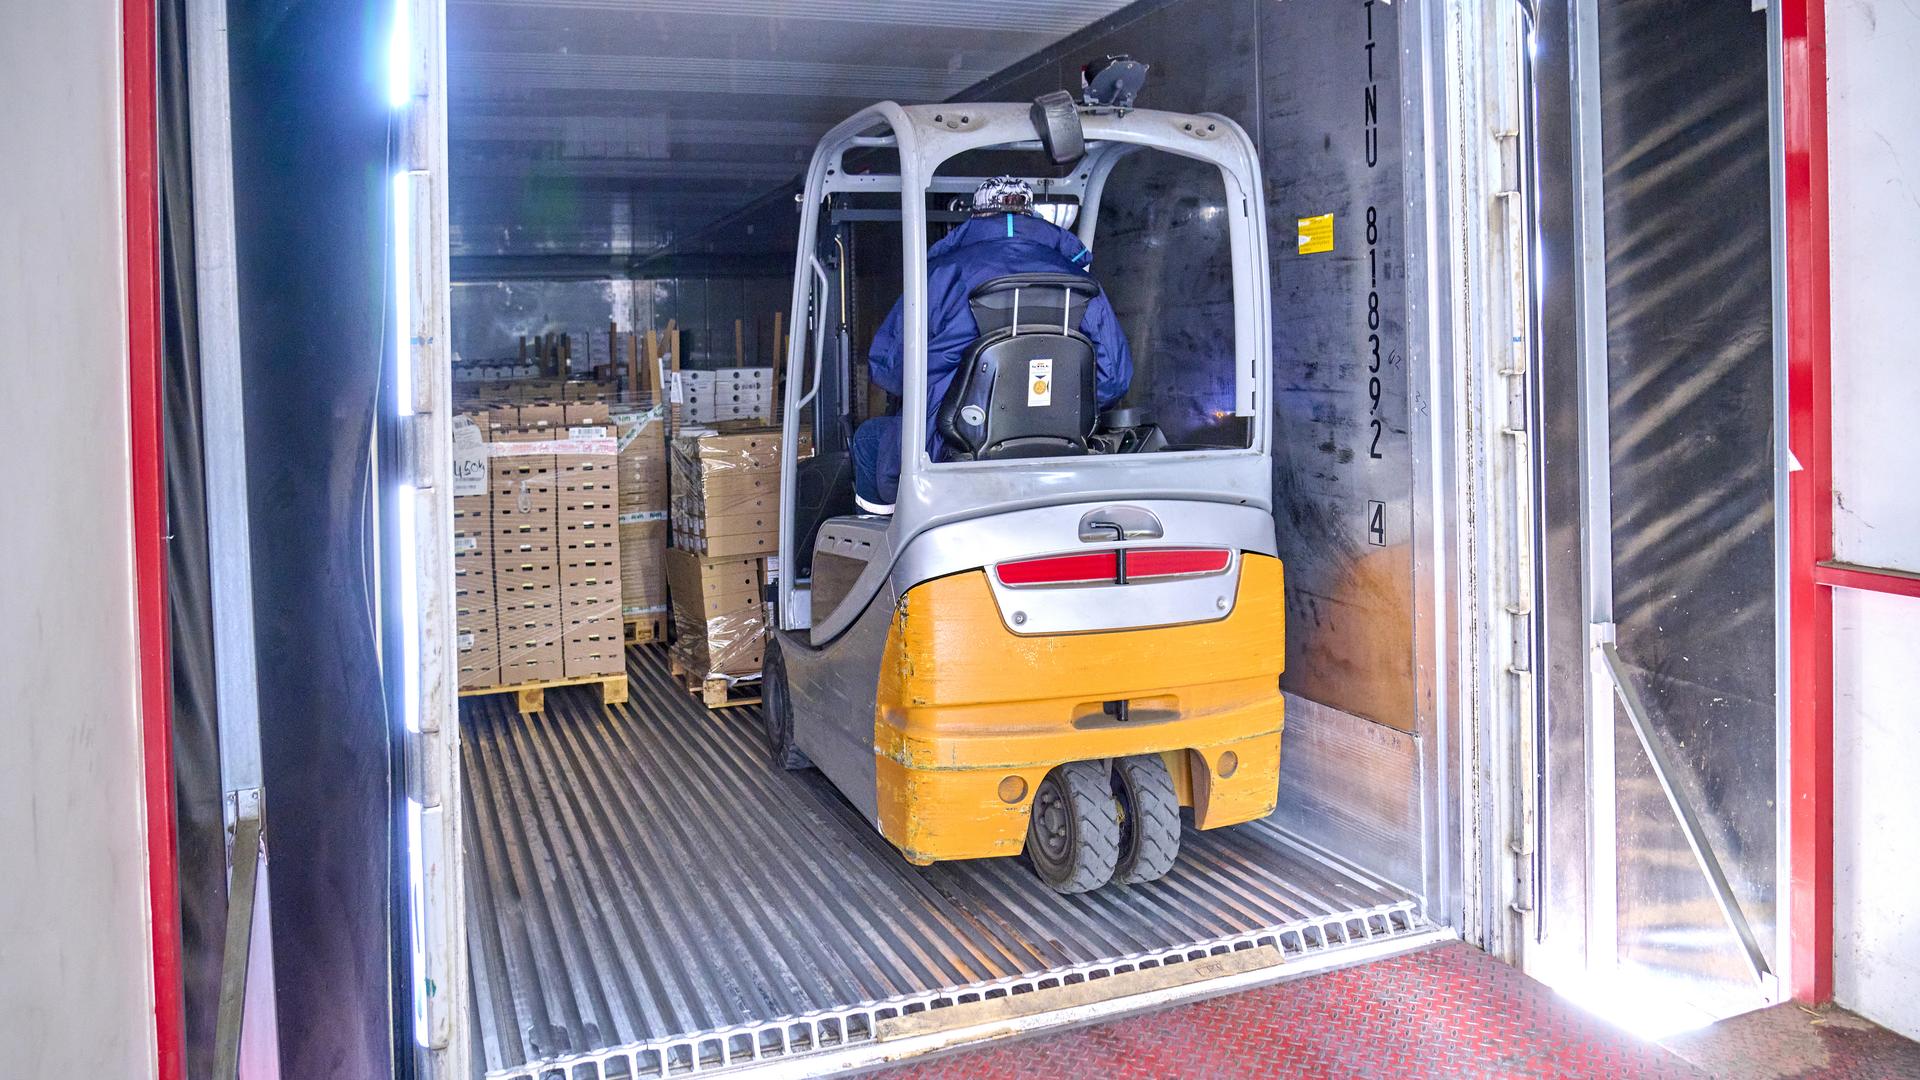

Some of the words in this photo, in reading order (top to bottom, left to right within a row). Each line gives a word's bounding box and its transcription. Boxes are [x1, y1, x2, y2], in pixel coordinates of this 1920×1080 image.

[1364, 0, 1377, 168] TTNU
[1366, 206, 1382, 459] 818392
[1371, 504, 1383, 544] 4
